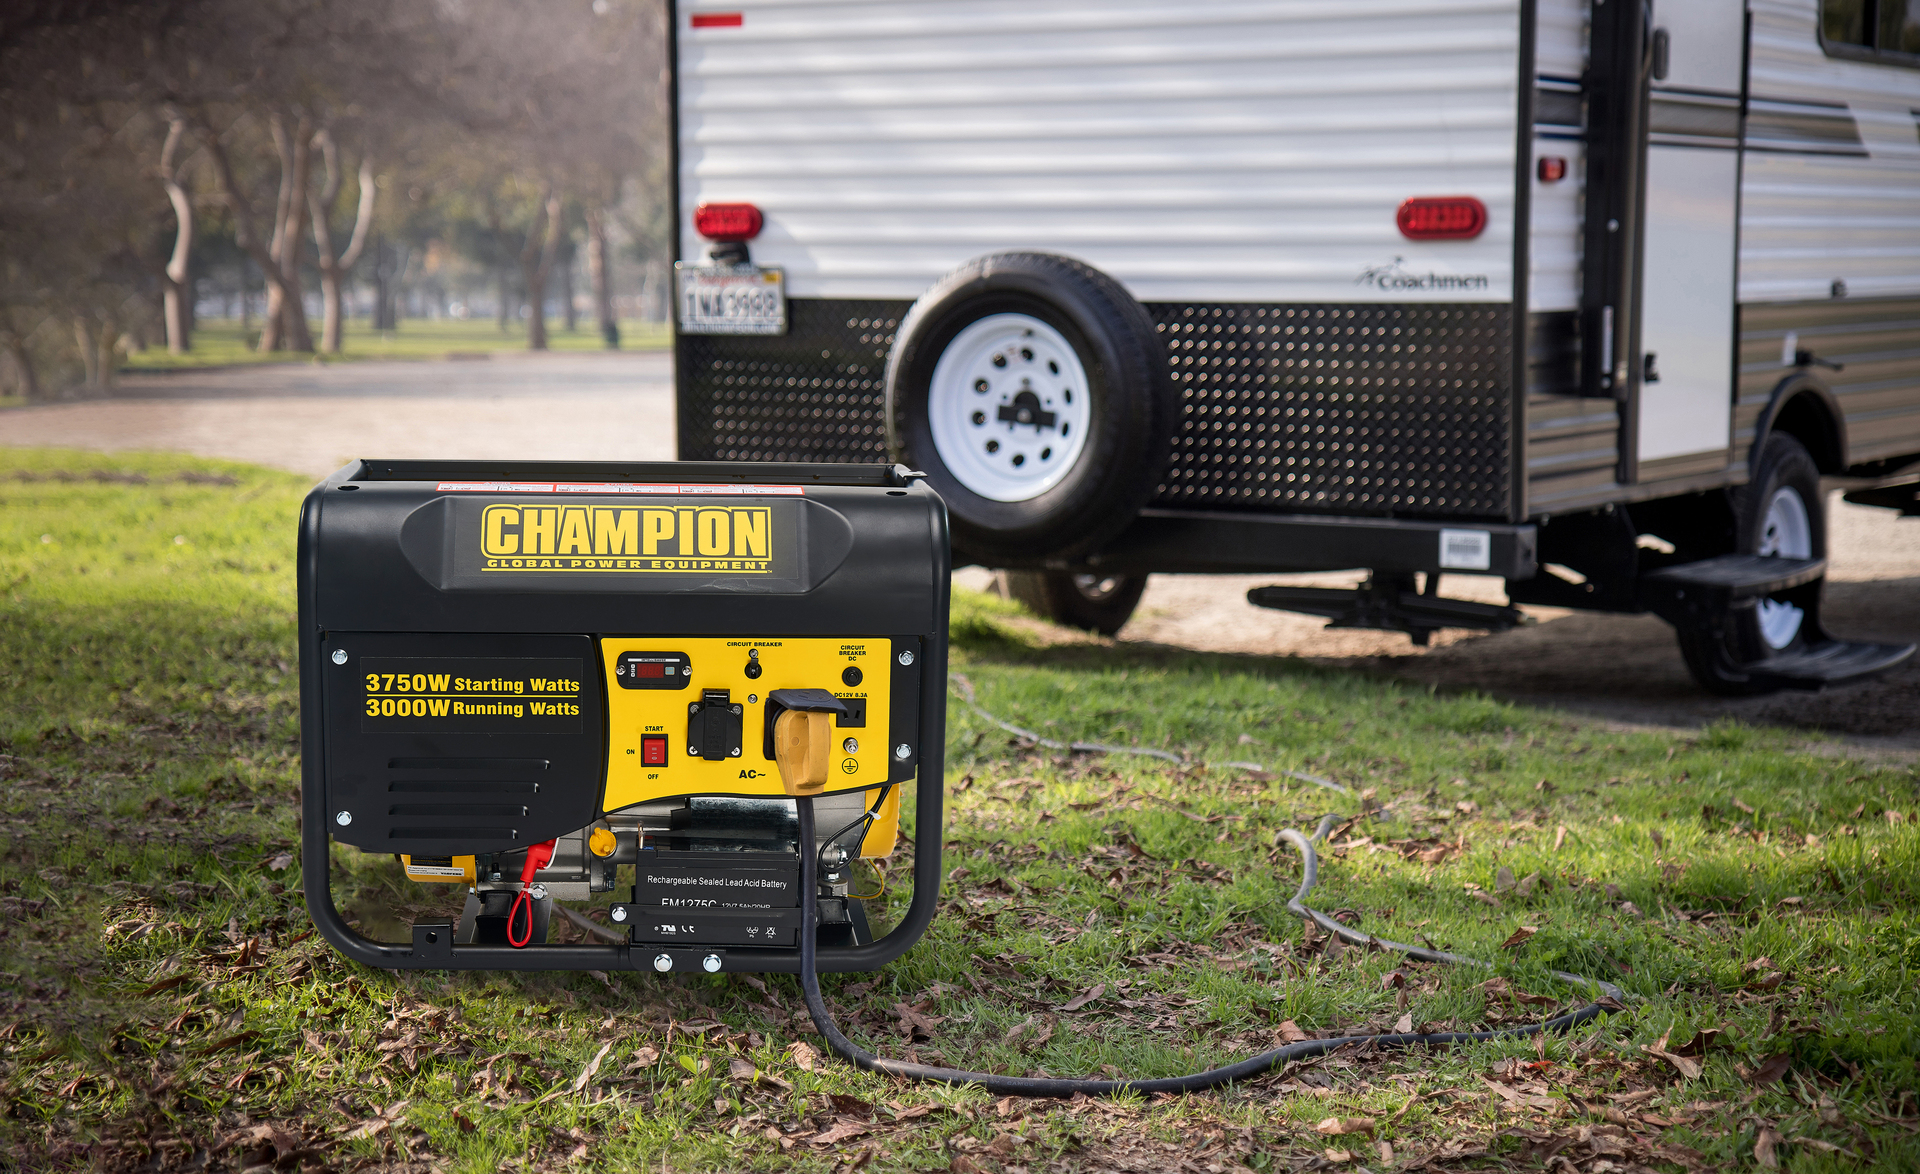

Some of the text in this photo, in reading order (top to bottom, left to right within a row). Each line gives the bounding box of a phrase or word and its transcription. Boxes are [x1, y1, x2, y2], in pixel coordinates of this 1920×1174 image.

[1378, 271, 1488, 291] Coachmen
[485, 508, 767, 557] CHAMPION
[487, 559, 768, 570] GLOBAL POWER EQUIPMENT
[365, 673, 580, 694] 3750W Starting Watts
[365, 699, 580, 718] 3000W Running Watts
[647, 875, 787, 890] Rechargeable Sealed Lead Acid Battery
